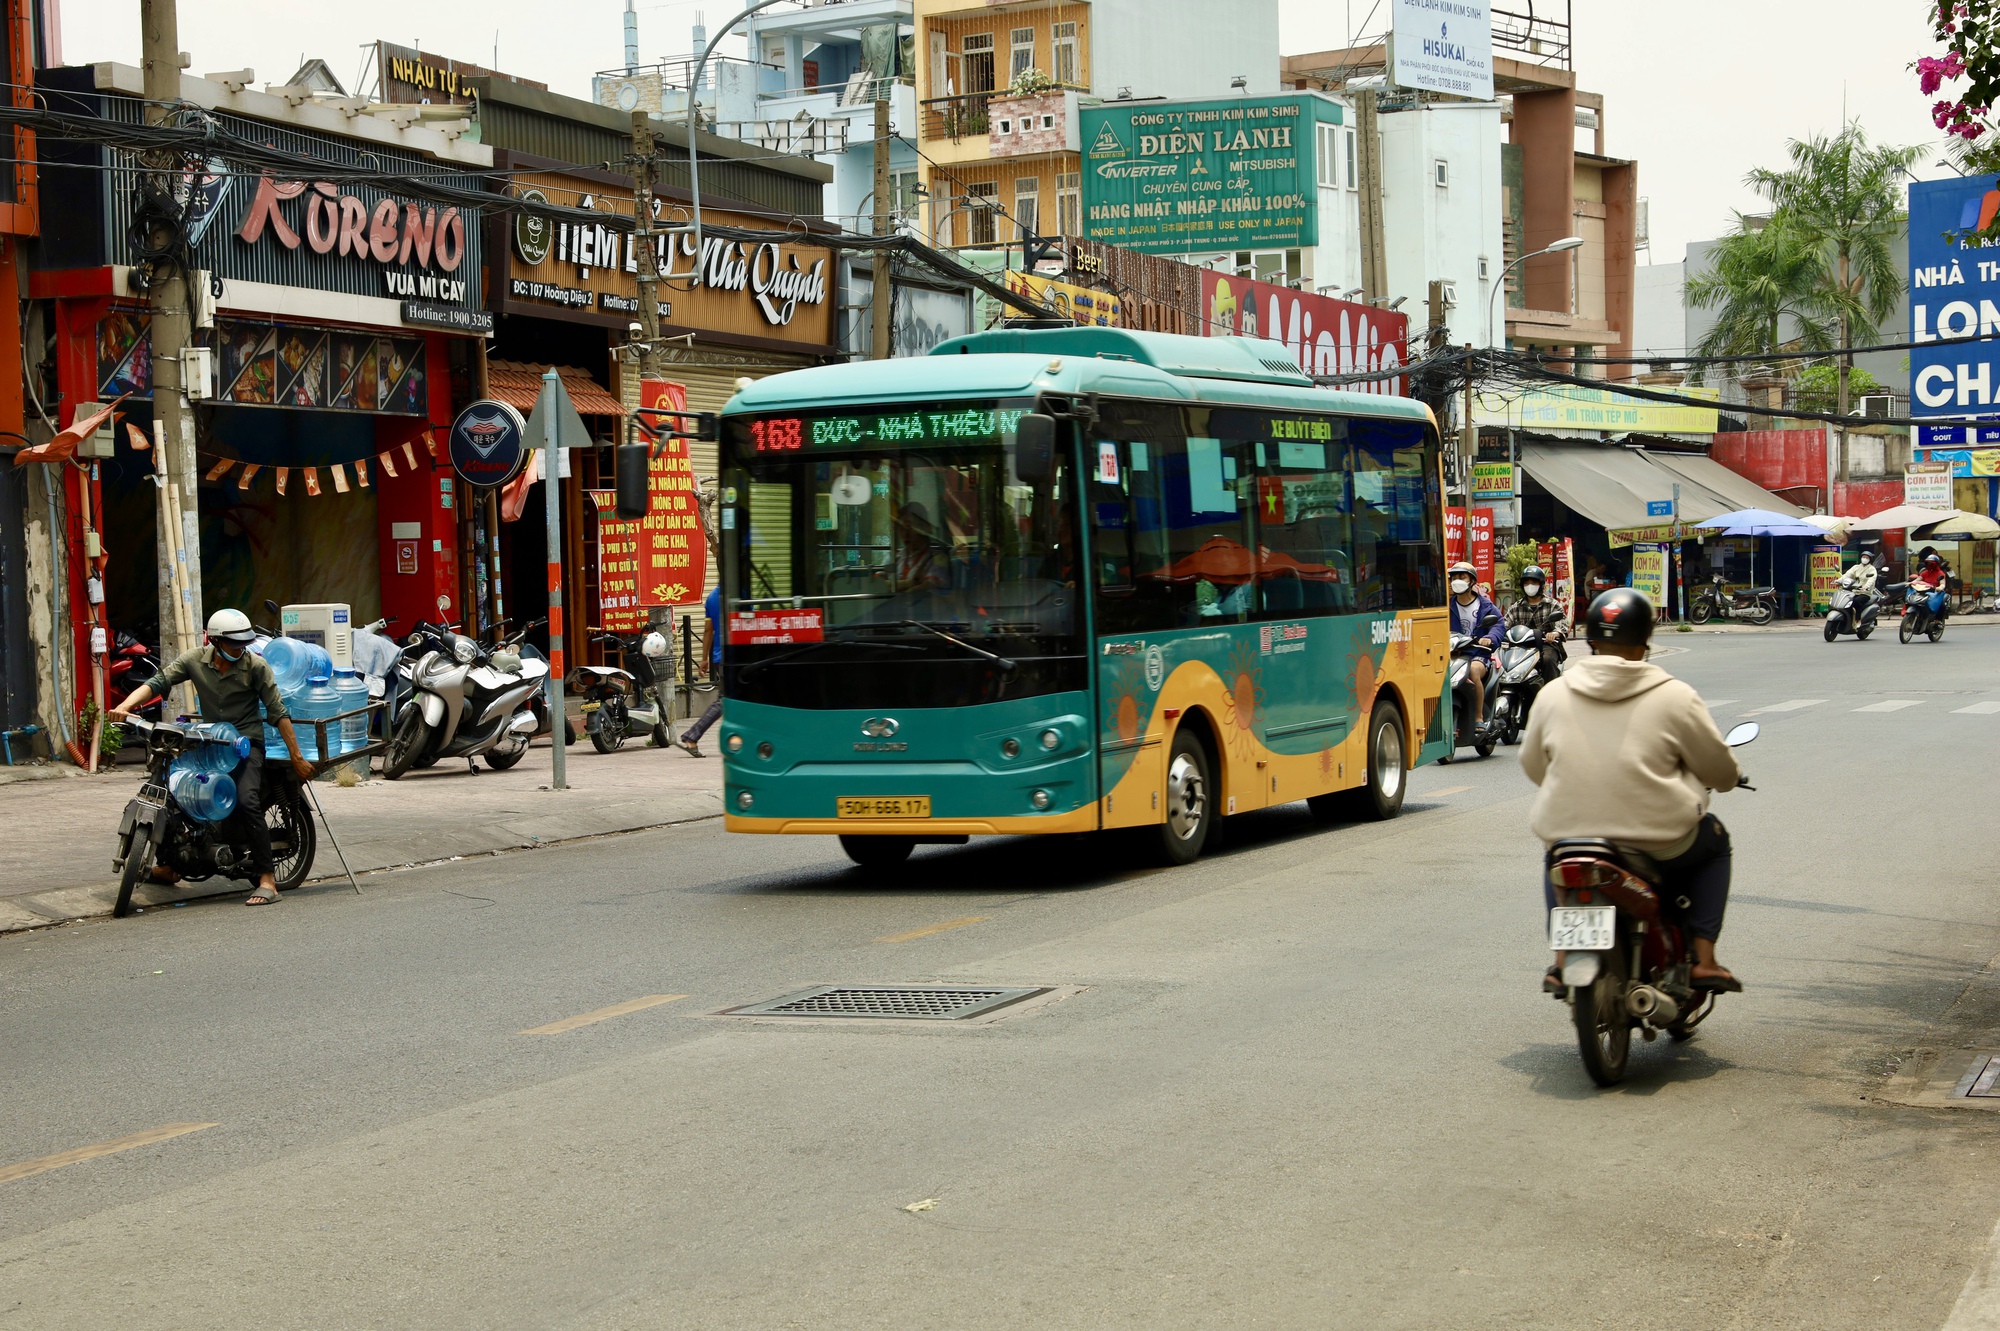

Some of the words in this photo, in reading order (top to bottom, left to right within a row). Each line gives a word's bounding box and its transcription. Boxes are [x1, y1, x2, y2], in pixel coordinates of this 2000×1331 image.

[1440, 2, 1452, 13] KIM
[1454, 5, 1466, 16] KIM
[1467, 7, 1482, 20] SINH
[392, 57, 434, 90] NHẬU
[438, 69, 457, 98] TỰ
[1131, 110, 1164, 126] CÔNG
[1167, 112, 1184, 123] TY
[1188, 110, 1220, 122] TNHH
[1222, 108, 1244, 120] KIM
[1246, 106, 1268, 119] KIM
[1271, 105, 1300, 117] SINH
[1140, 126, 1204, 160] ĐIỆN
[1214, 126, 1292, 156] LẠNH
[1104, 164, 1178, 179] INVERTER
[1230, 158, 1295, 172] MITSUBISHI
[1143, 178, 1188, 194] CHUYÊN
[1192, 180, 1222, 192] CUNG
[1090, 200, 1130, 220] HÀNG
[1134, 198, 1172, 221] NHẬT
[1177, 195, 1217, 218] NHẬP
[1222, 187, 1262, 212] KHẨU
[1265, 193, 1306, 210] 100%
[1090, 226, 1115, 237] MADE
[1118, 226, 1126, 235] IN
[1128, 225, 1156, 234] JAPAN
[1218, 220, 1236, 230] USE
[1238, 219, 1260, 229] ONLY
[1263, 218, 1272, 227] IN
[1275, 217, 1303, 227] JAPAN
[1076, 246, 1102, 274] Beer
[1914, 258, 1965, 288] NHÀ
[386, 270, 416, 296] VUA
[420, 270, 437, 298] MÌ
[440, 279, 466, 302] CAY
[751, 242, 825, 326] Quỳnh
[513, 280, 528, 296] ĐC:
[530, 282, 543, 298] 107
[544, 284, 569, 306] Hoàng
[570, 289, 587, 308] Diệu
[587, 292, 593, 304] 2
[604, 294, 630, 312] Hotline:
[408, 304, 447, 322] Hotline:
[448, 310, 470, 326] 1900
[471, 312, 492, 328] 3205
[1915, 362, 2000, 408] CH
[1566, 406, 1578, 421] MÌ
[1580, 407, 1603, 426] TRỘN
[1605, 407, 1621, 424] TÉP
[751, 418, 802, 450] 168
[1271, 419, 1284, 438] XE
[1285, 416, 1310, 439] BUÝT
[669, 439, 680, 452] HUY
[664, 455, 678, 471] LÀM
[658, 474, 676, 491] NHÂN
[678, 474, 692, 490] DÂN
[1477, 478, 1492, 490] LAN
[1494, 477, 1511, 489] ANH
[1907, 475, 1926, 485] CƠM
[1929, 474, 1948, 484] TẤM
[674, 496, 687, 511] QUA
[655, 511, 665, 529] CỬ
[667, 512, 680, 529] DÂN
[606, 524, 614, 535] NV
[607, 542, 620, 556] PHỤ
[670, 534, 688, 550] KHAI,
[602, 562, 606, 573] 4
[608, 561, 617, 572] NV
[1635, 556, 1647, 570] CƠM
[1649, 554, 1660, 570] TẤM
[1813, 556, 1825, 568] CƠM
[604, 582, 608, 592] 3
[610, 580, 624, 594] TẠP
[620, 594, 629, 608] HỆ
[1371, 618, 1412, 644] 50H-666.17
[846, 800, 922, 814] 50H-666.17
